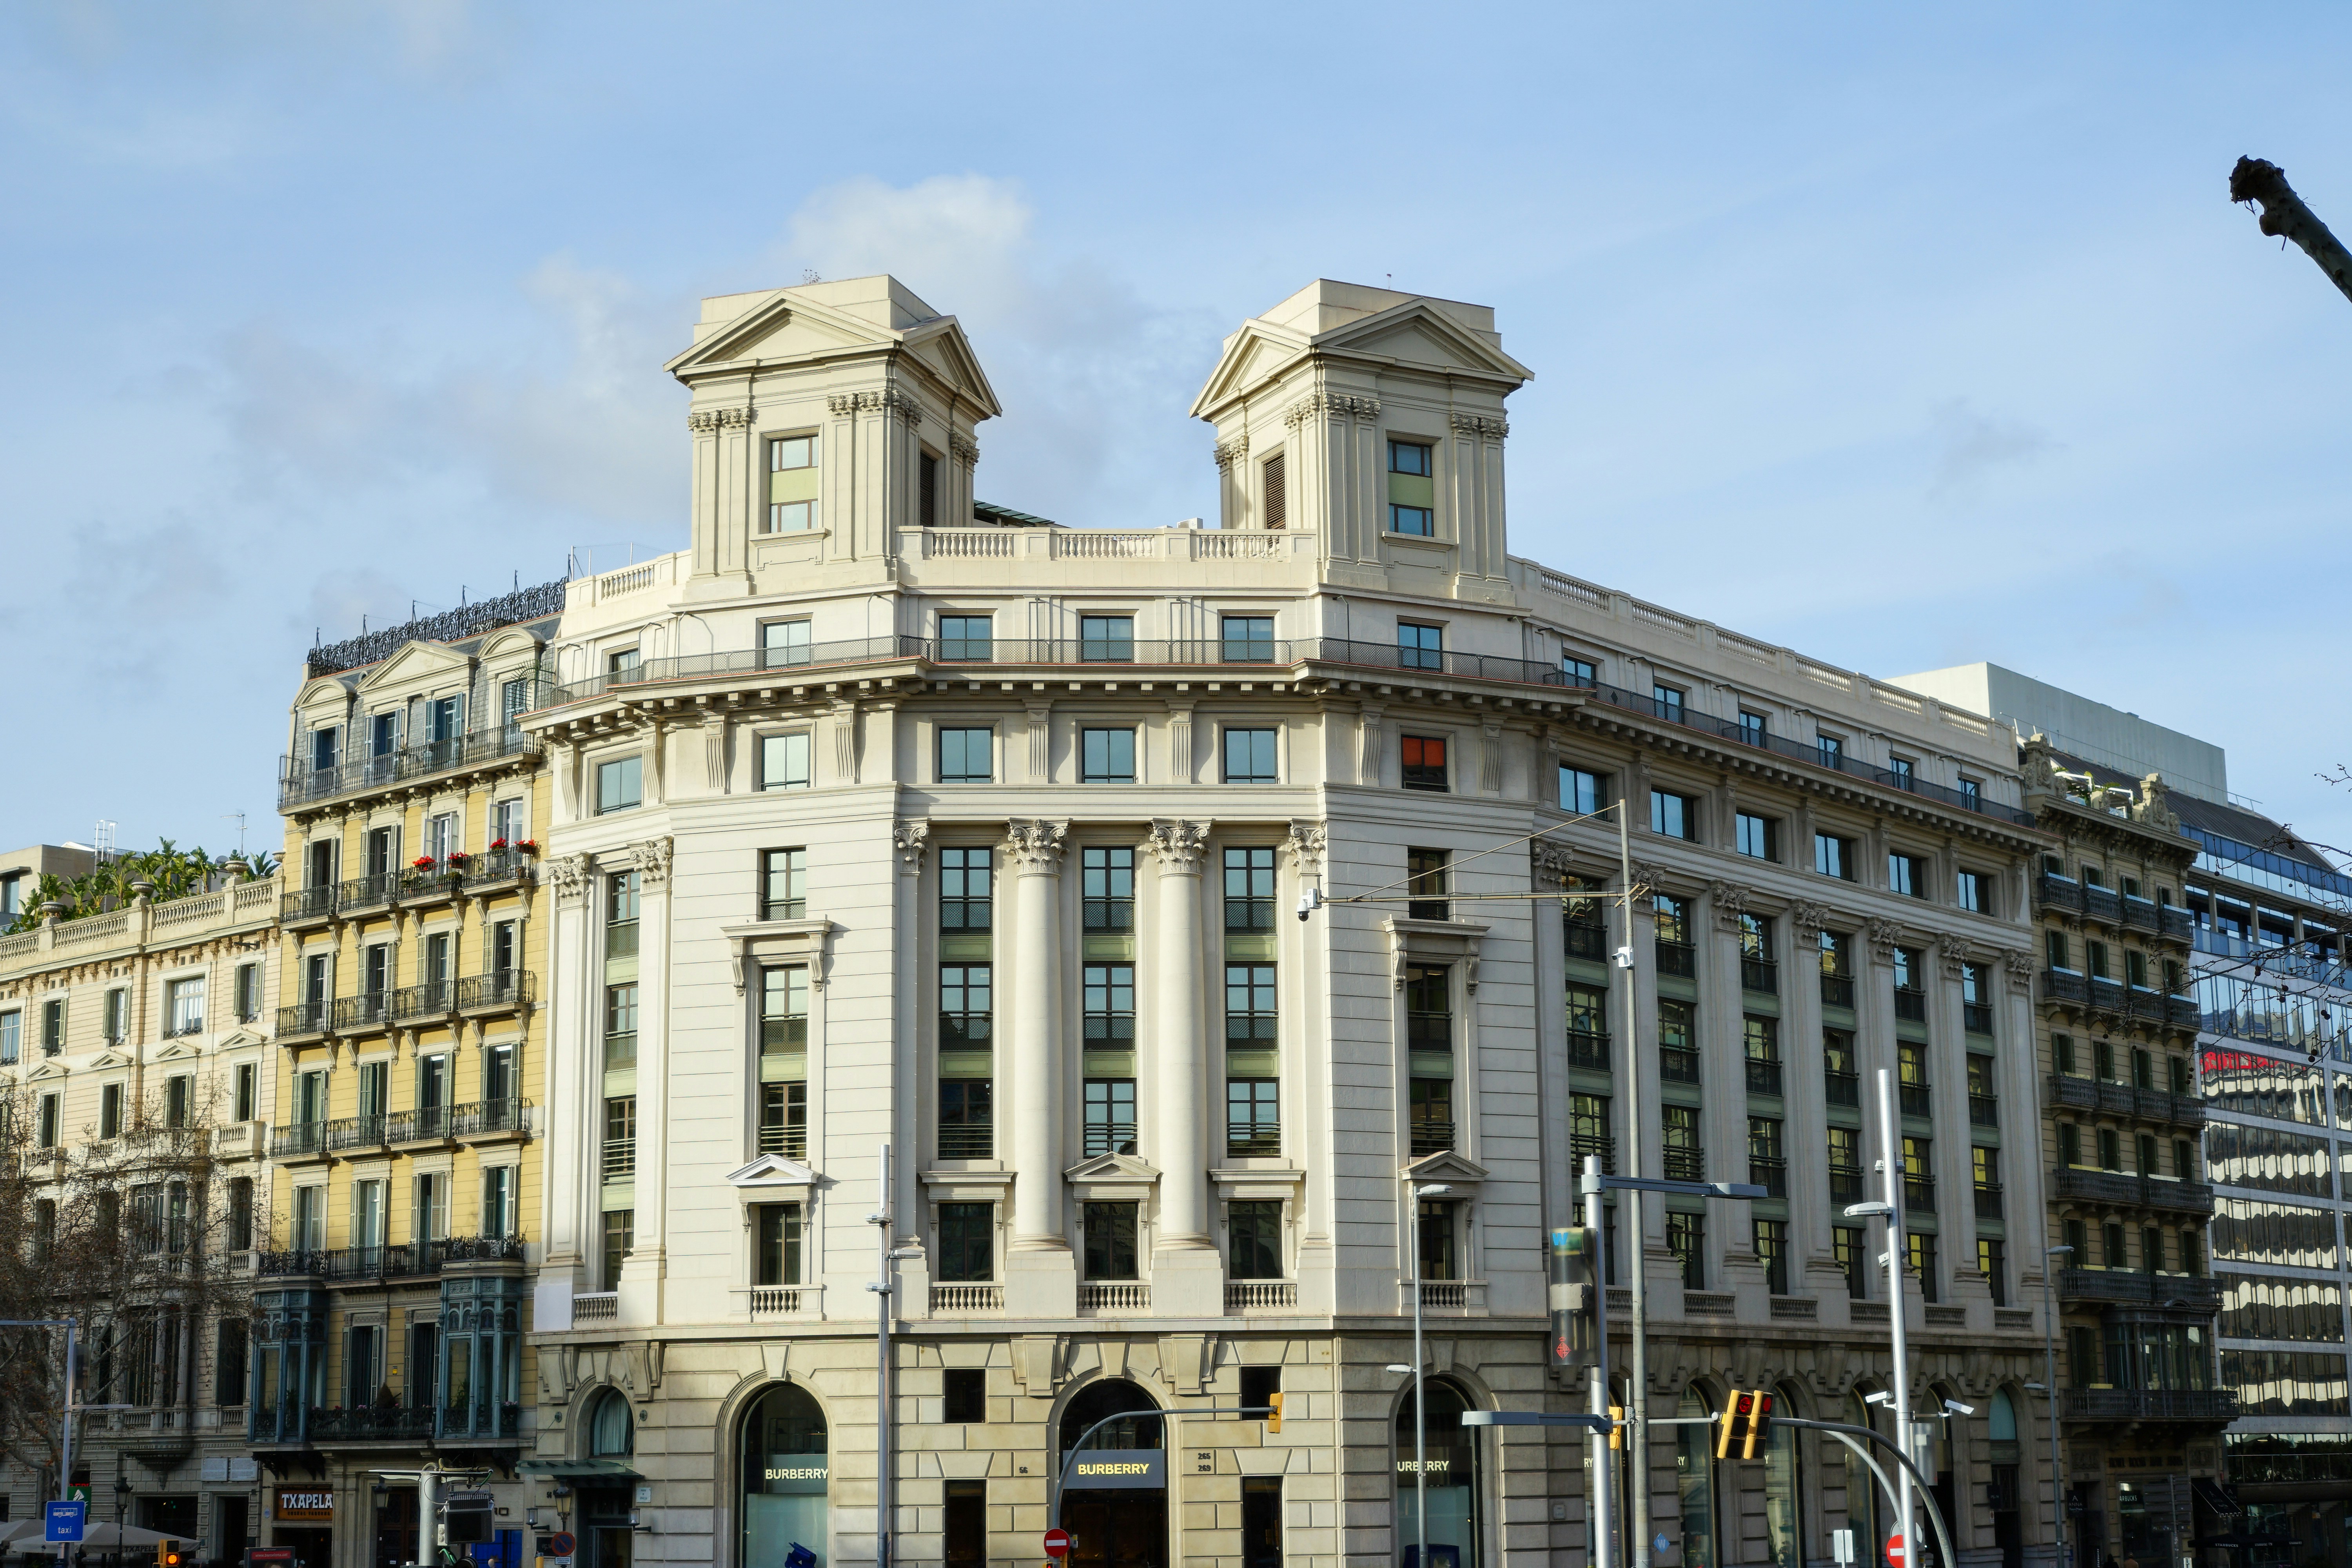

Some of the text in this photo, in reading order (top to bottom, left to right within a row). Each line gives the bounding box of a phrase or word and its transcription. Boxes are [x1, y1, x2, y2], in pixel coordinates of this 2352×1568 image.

[1552, 1232, 1568, 1246] W
[1078, 1464, 1149, 1475] BURBERRY
[1397, 1461, 1449, 1472] URBRRY
[766, 1468, 828, 1480] BURBERRY
[282, 1494, 333, 1508] TXAPELA
[58, 1526, 72, 1534] taxi
[1657, 1539, 1666, 1548] W
